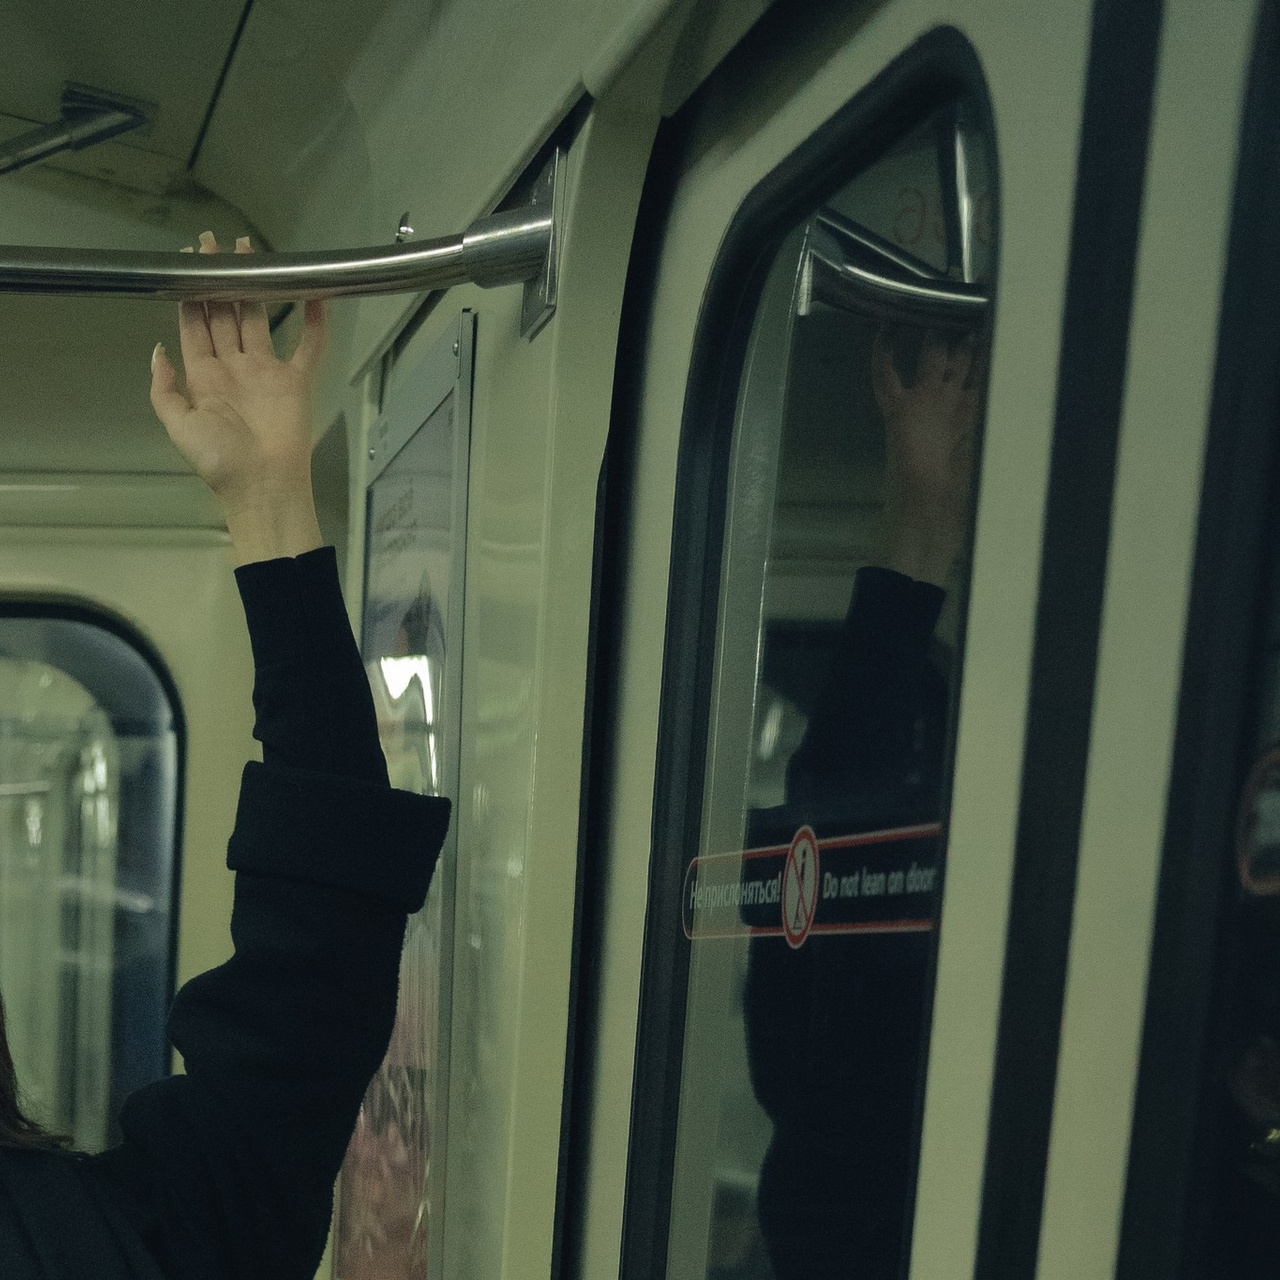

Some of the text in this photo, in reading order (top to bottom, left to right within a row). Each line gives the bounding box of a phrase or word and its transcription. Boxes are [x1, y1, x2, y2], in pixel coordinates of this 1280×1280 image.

[823, 861, 937, 899] Do not lean on door
